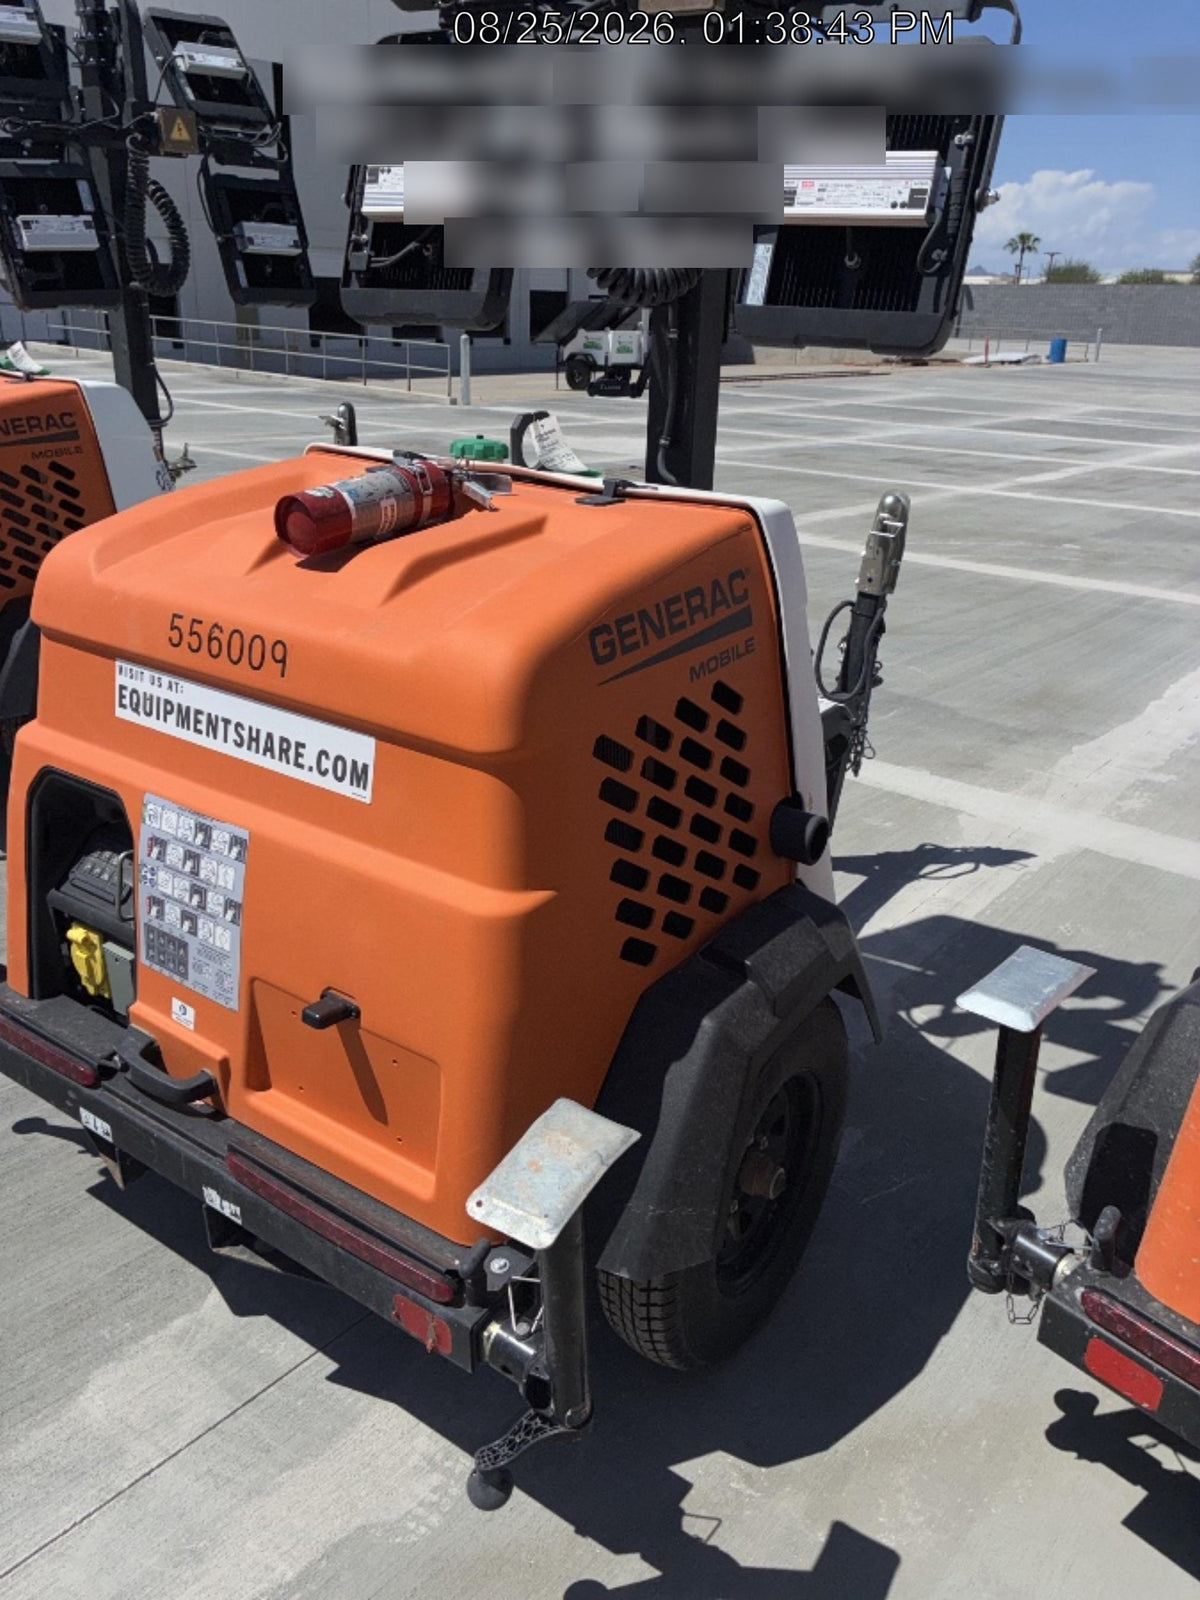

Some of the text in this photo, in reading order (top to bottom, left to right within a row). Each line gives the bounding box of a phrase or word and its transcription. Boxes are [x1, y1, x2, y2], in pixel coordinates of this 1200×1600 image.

[31, 445, 84, 460] MOBILE
[168, 612, 288, 678] 556009
[588, 568, 750, 666] GENERAC
[118, 664, 184, 695] VISIT US AT:
[688, 636, 756, 683] MOBILE
[117, 683, 370, 791] EQUIPMENTSHARE.COM
